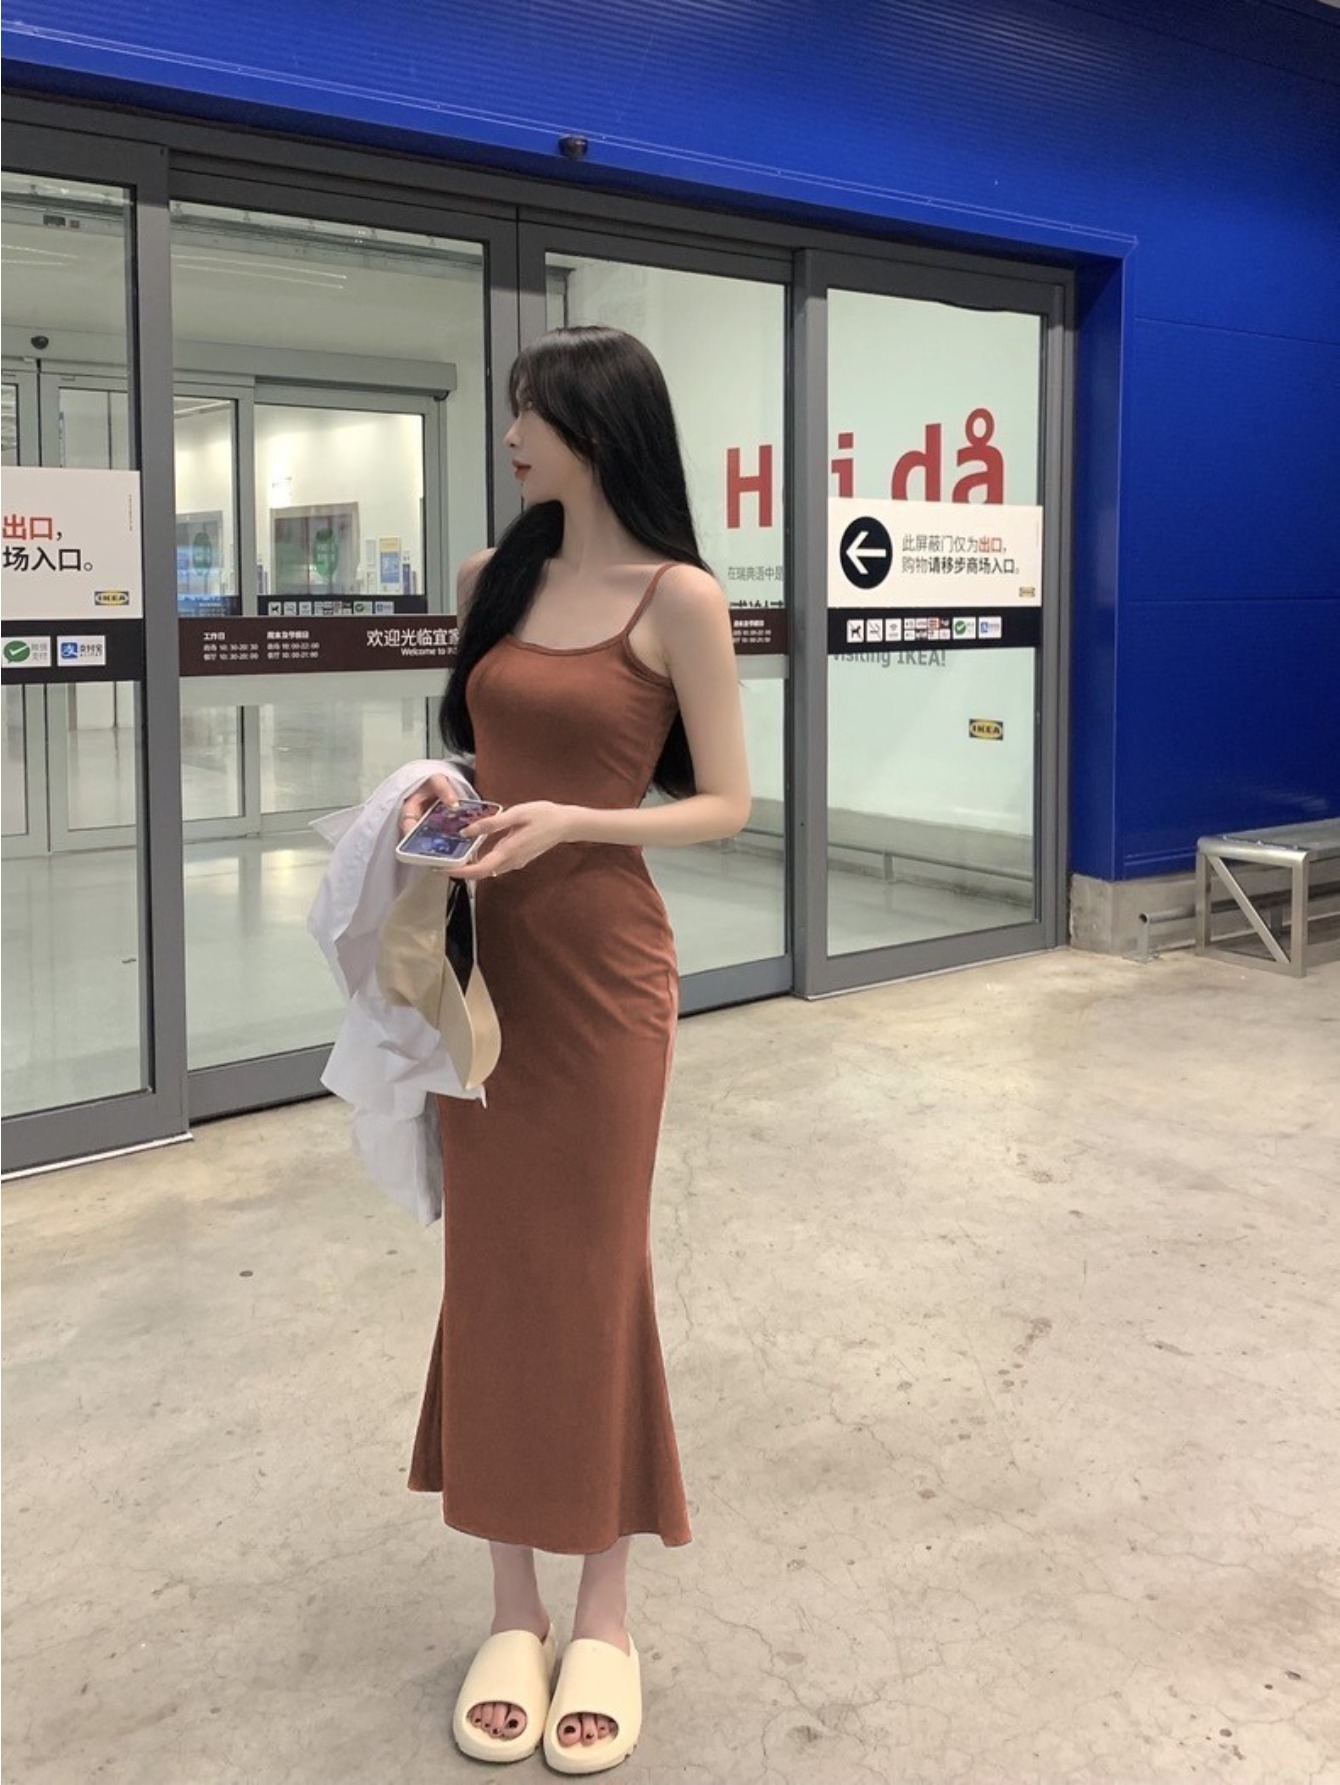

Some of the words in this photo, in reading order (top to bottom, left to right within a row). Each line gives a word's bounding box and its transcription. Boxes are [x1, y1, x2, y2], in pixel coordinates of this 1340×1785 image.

[891, 408, 1004, 505] då
[401, 647, 436, 656] Welcome
[437, 647, 446, 655] to
[897, 649, 946, 667] IKEA!
